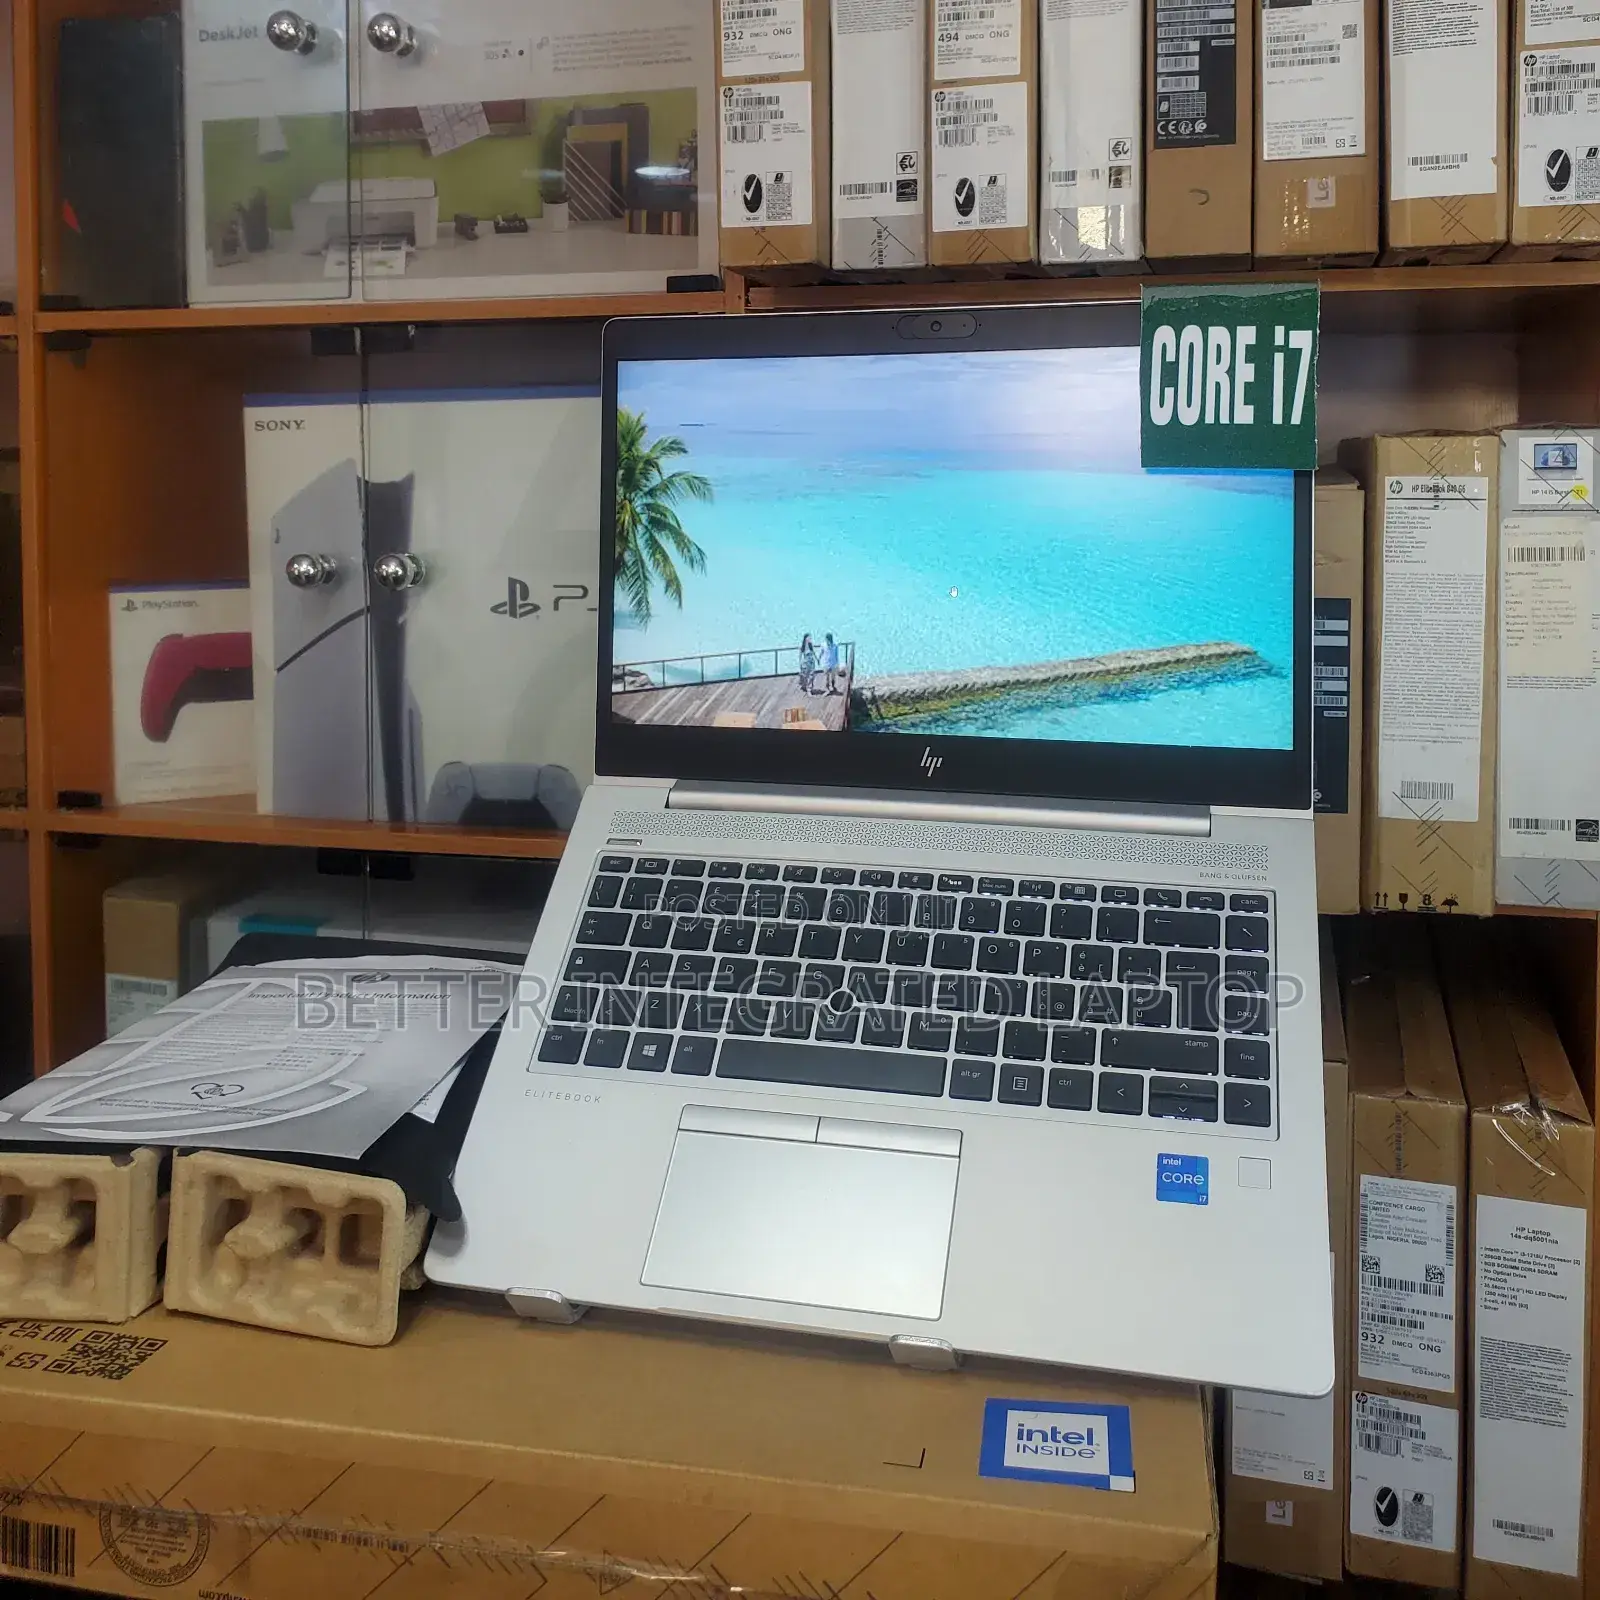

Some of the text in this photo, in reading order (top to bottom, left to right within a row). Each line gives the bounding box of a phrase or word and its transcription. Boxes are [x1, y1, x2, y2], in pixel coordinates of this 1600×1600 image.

[198, 26, 258, 42] DeskJet
[724, 31, 744, 41] 932
[772, 28, 792, 36] ONG
[938, 33, 959, 42] 494
[1150, 325, 1312, 426] CORE i7
[254, 420, 305, 431] SONY
[1390, 480, 1403, 494] hp
[1412, 485, 1420, 493] HP
[142, 600, 199, 611] PlayStation
[920, 746, 943, 777] hp
[794, 904, 800, 913] 5
[836, 907, 842, 915] 6
[923, 912, 930, 921] 8
[968, 916, 975, 924] 9
[642, 921, 652, 930] Q
[684, 923, 695, 932] W
[724, 926, 732, 935] E
[766, 929, 774, 938] R
[810, 932, 817, 940] T
[854, 934, 862, 943] Y
[897, 938, 905, 947] U
[988, 945, 998, 954] O
[1033, 949, 1042, 957] P
[641, 959, 650, 968] A
[683, 962, 691, 970] S
[725, 965, 734, 974] D
[769, 968, 776, 976] F
[813, 971, 823, 979] G
[857, 974, 866, 982] H
[902, 978, 909, 987] J
[947, 982, 957, 992] K
[248, 992, 316, 1001] Important
[369, 991, 452, 1000] Information
[651, 1000, 659, 1009] Z
[693, 1002, 702, 1012] X
[1054, 1002, 1065, 1011] @
[738, 1007, 747, 1016] C
[783, 1009, 792, 1018] V
[827, 1015, 835, 1024] B
[872, 1016, 882, 1026] N
[919, 1021, 930, 1031] M
[1185, 1040, 1209, 1048] stamp
[524, 1089, 602, 1104] ELITEBOOK
[1162, 1157, 1181, 1166] intel
[1368, 1200, 1404, 1210] CONFIDENCE
[1527, 1228, 1551, 1237] Laptop
[1544, 1255, 1572, 1264] Processor
[1548, 1292, 1568, 1300] Display
[1361, 1332, 1385, 1345] 932
[1419, 1343, 1442, 1353] ONG
[1017, 1423, 1094, 1446] intel
